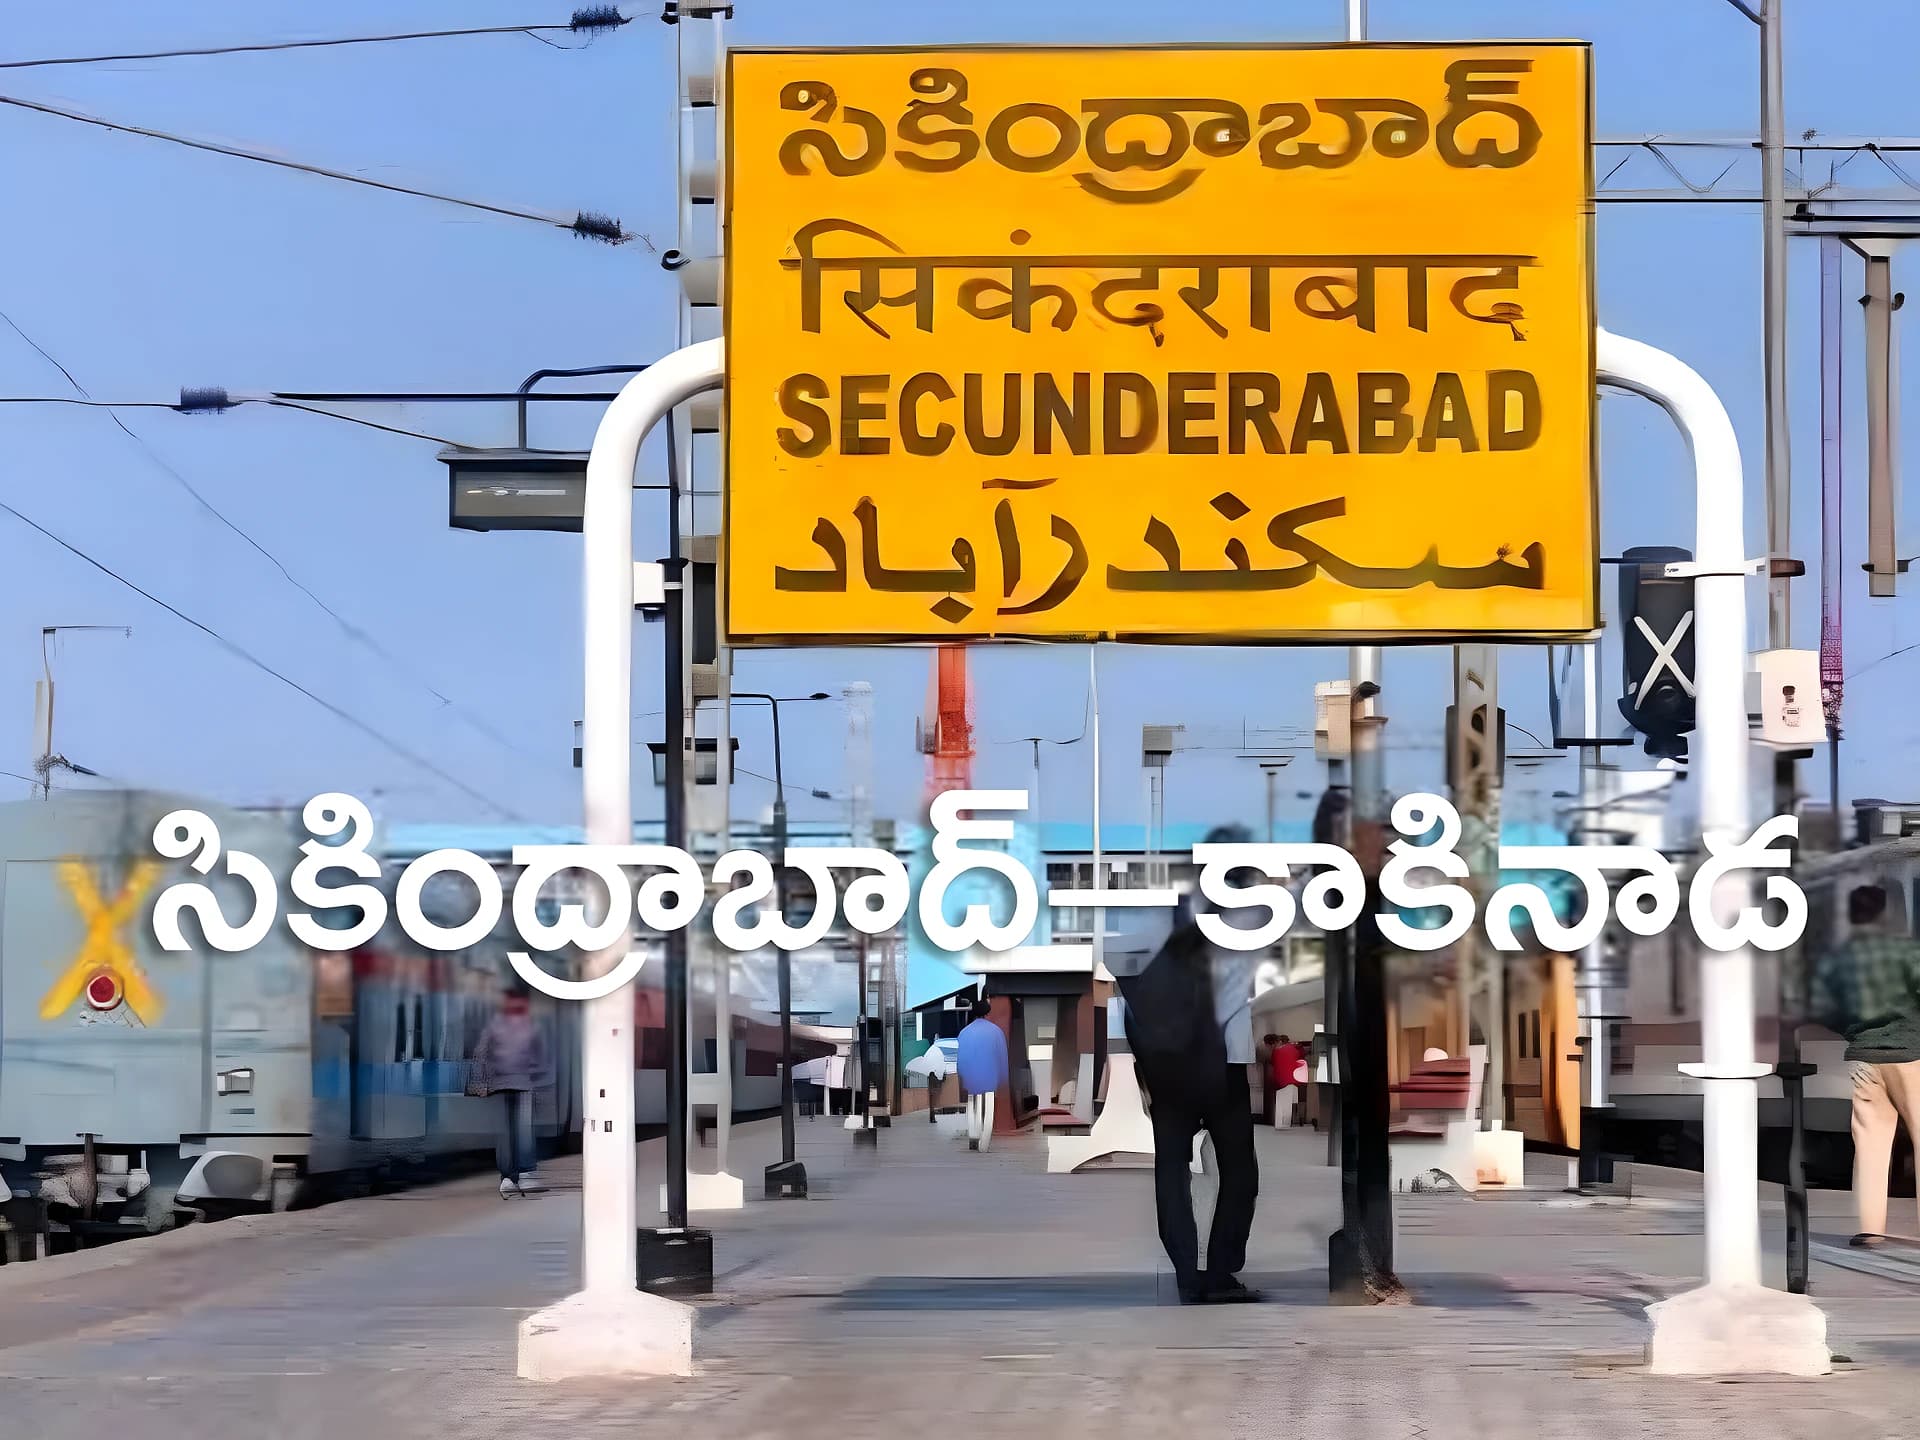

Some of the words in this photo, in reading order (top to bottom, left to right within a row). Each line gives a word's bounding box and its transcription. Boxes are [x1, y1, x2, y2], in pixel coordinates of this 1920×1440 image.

[779, 59, 1540, 205] సికింద్రాబాద్
[778, 217, 1543, 344] सिकंदराबाद
[776, 369, 1542, 458] SECUNDERABAD
